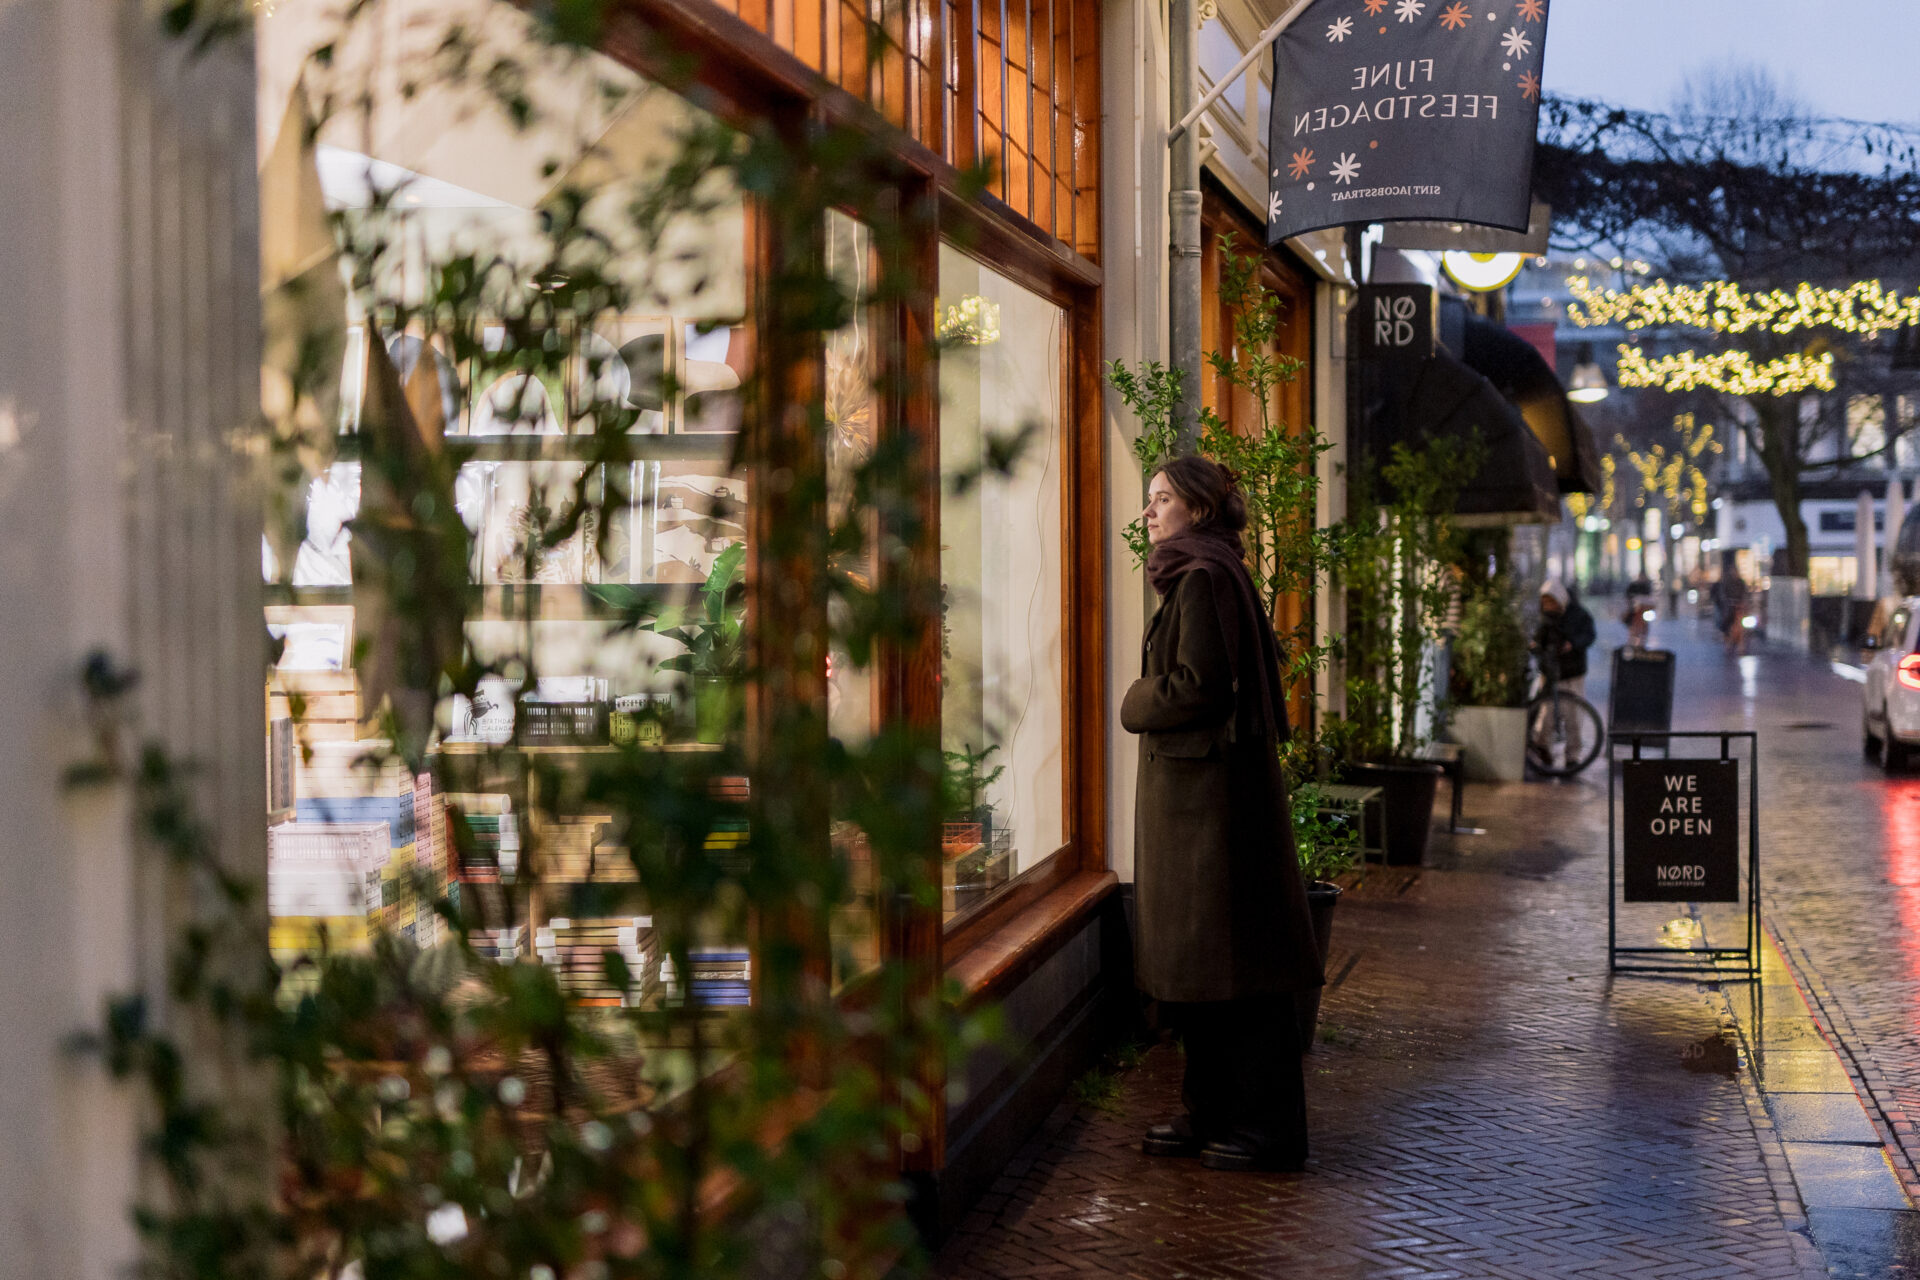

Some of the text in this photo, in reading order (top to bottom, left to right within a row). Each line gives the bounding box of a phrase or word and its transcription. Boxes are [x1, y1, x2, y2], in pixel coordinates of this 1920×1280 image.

[1374, 320, 1415, 346] RD
[1664, 775, 1697, 792] WE
[1660, 797, 1702, 814] ARE
[1651, 818, 1712, 835] OPEN
[1657, 865, 1705, 880] NØRD
